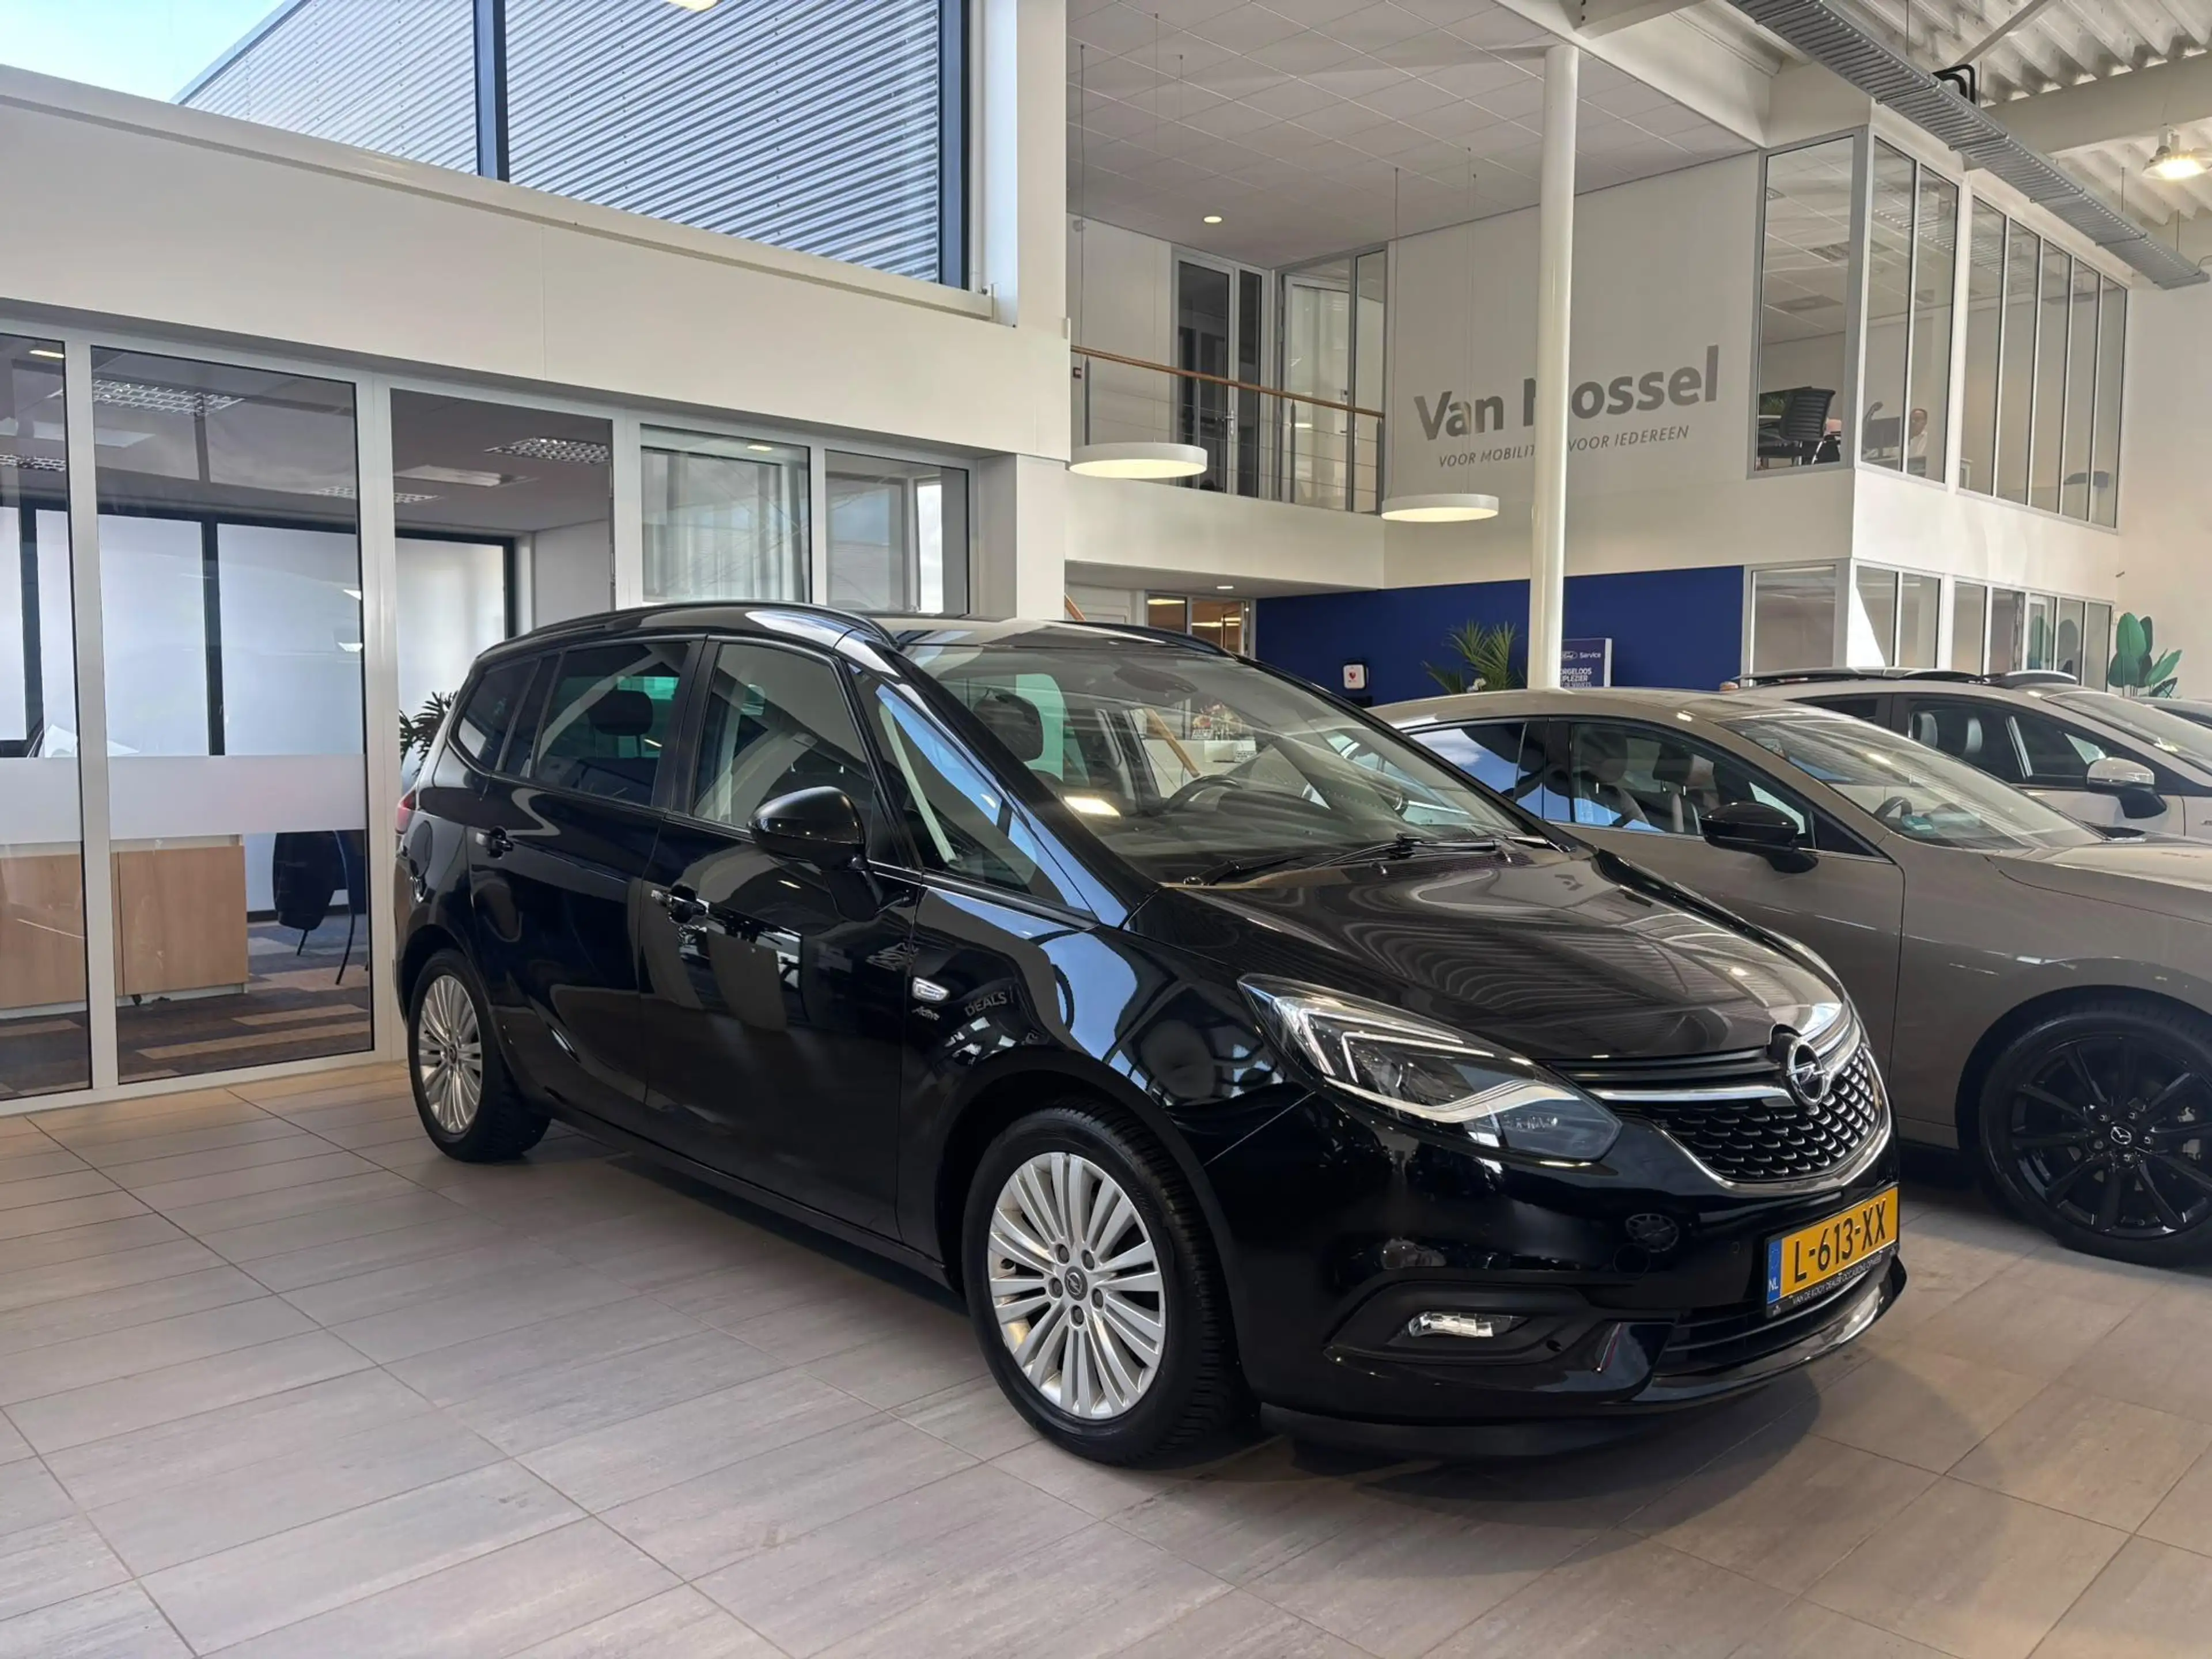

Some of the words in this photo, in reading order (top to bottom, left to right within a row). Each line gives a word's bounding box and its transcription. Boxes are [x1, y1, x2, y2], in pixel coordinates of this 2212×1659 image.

[1414, 390, 1504, 441] Van
[1523, 344, 1719, 427] ossel
[1440, 452, 1476, 468] VOOR
[1480, 444, 1535, 463] MOBILIT
[1568, 434, 1609, 452] VOOR
[1614, 425, 1690, 448] IEDEREEN
[1579, 652, 1601, 660] Service
[964, 991, 1008, 1017] DEALS
[1794, 1199, 1887, 1284] L-613-XX
[1768, 1278, 1779, 1291] NL
